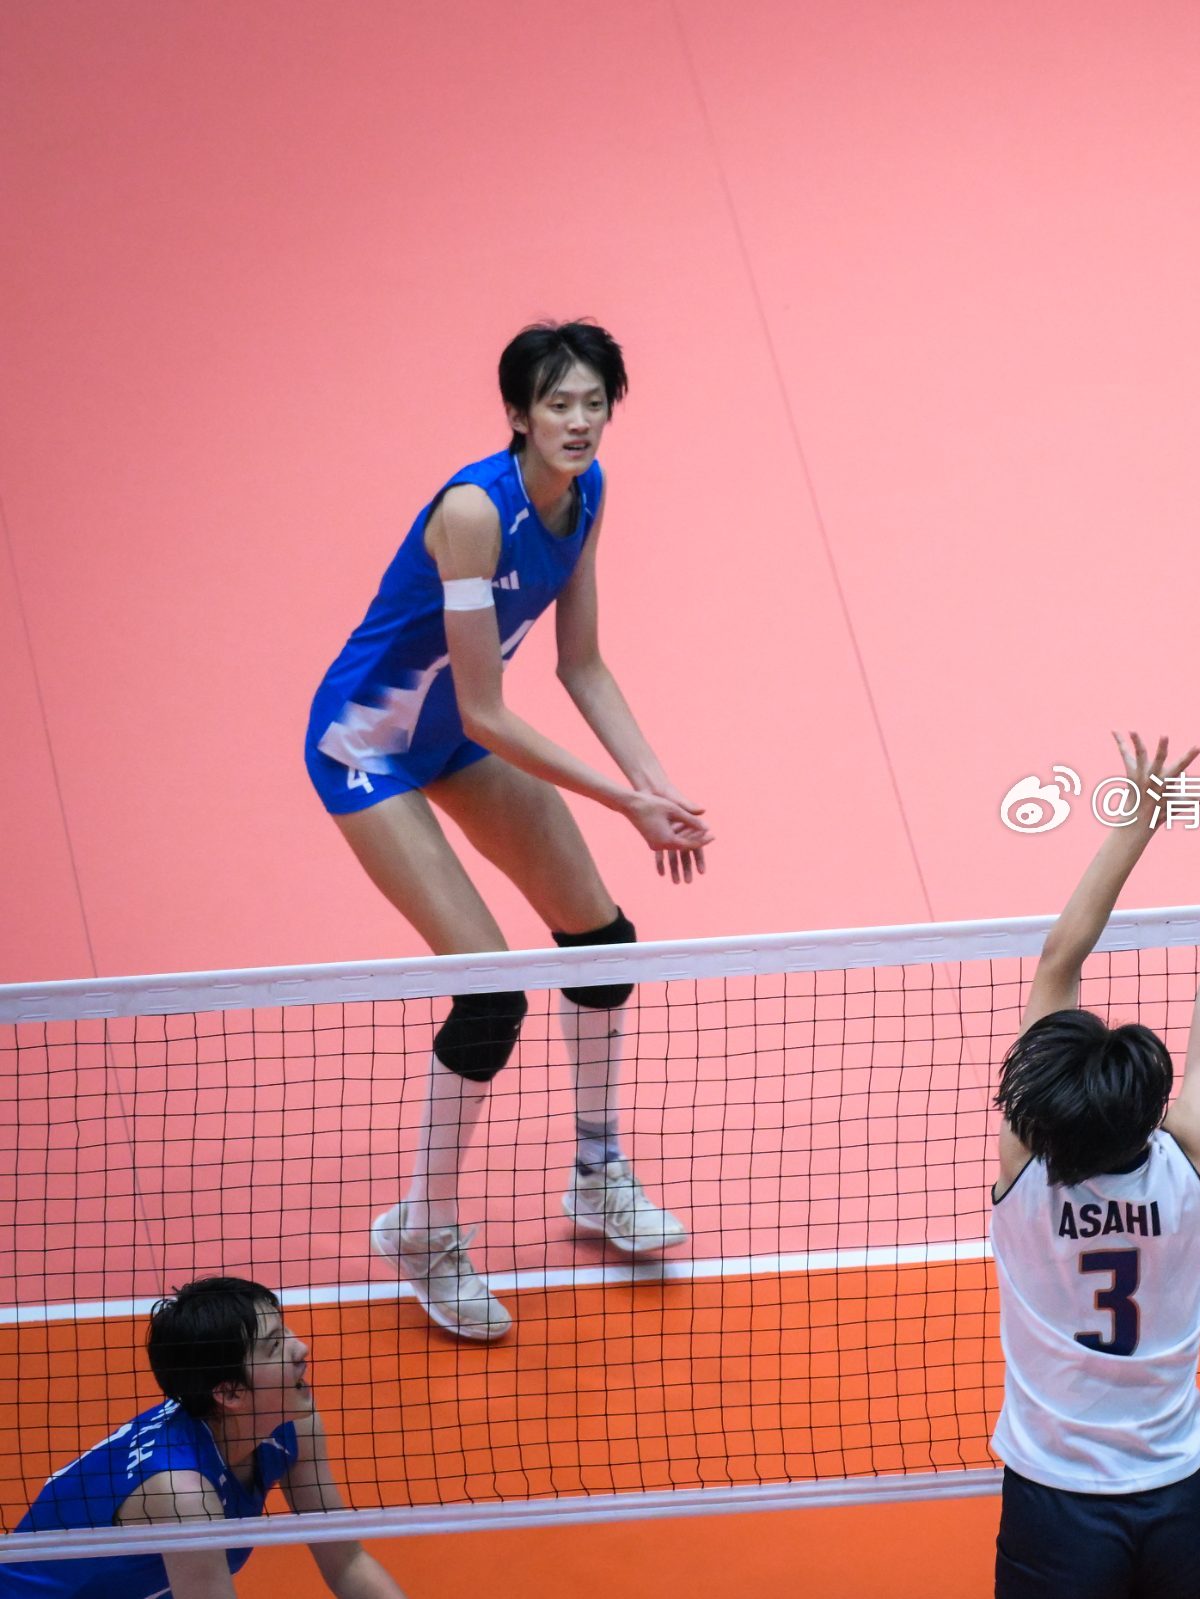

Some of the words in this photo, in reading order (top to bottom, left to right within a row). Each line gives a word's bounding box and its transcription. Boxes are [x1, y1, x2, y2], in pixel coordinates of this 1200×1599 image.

[346, 767, 375, 794] 4
[1058, 1200, 1162, 1240] ASAHI
[1073, 1247, 1141, 1357] 3
